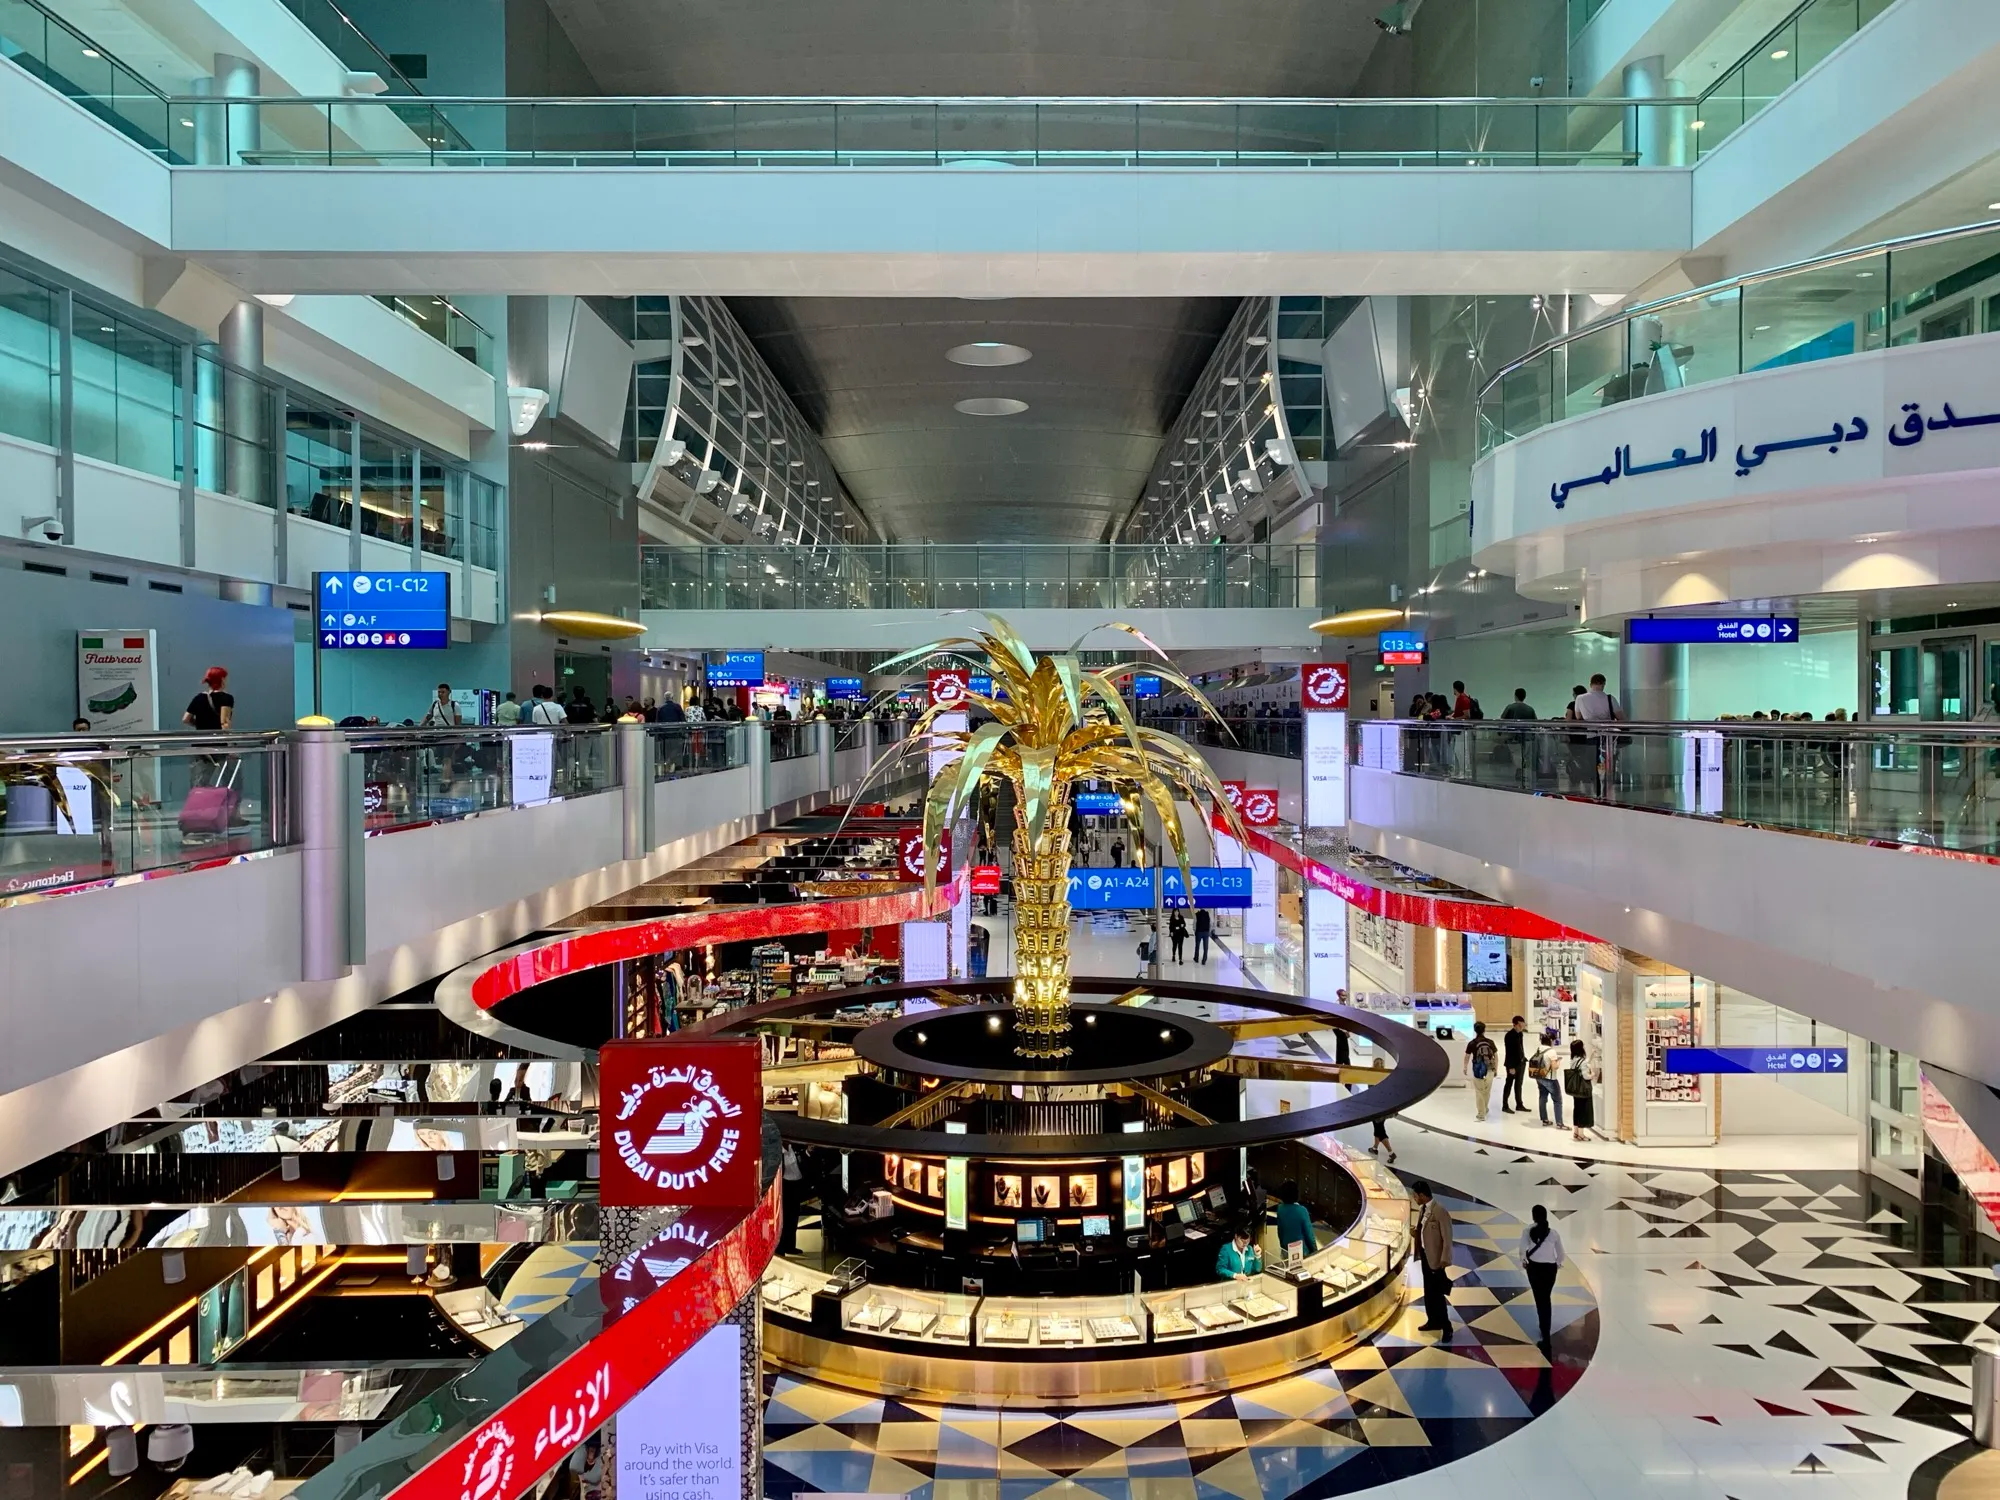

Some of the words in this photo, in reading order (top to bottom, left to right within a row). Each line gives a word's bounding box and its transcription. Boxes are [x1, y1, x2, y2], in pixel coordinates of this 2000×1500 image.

[1735, 416, 1869, 477] دبي
[1550, 427, 1717, 510] العالمي
[375, 578, 428, 592] C1-C12
[371, 615, 377, 625] F
[1717, 622, 1738, 631] الفندق
[1382, 640, 1404, 650] C13
[84, 653, 142, 664] Flatbread
[1320, 696, 1336, 705] DUTY
[1104, 877, 1149, 888] A1-A24
[1201, 877, 1243, 888] C1-C13
[1105, 892, 1111, 902] F
[910, 997, 928, 1005] VISA
[614, 1130, 655, 1182] DUBAI
[657, 1165, 708, 1190] DUTY
[708, 1128, 740, 1173] FREE
[640, 1443, 661, 1457] Pay
[665, 1442, 692, 1454] with
[695, 1442, 719, 1454] Visa
[624, 1458, 669, 1470] around
[672, 1458, 693, 1469] the
[696, 1457, 735, 1469] world.
[659, 1473, 688, 1485] safer
[692, 1472, 720, 1484] than
[645, 1489, 679, 1500] using
[683, 1488, 714, 1500] cash.
